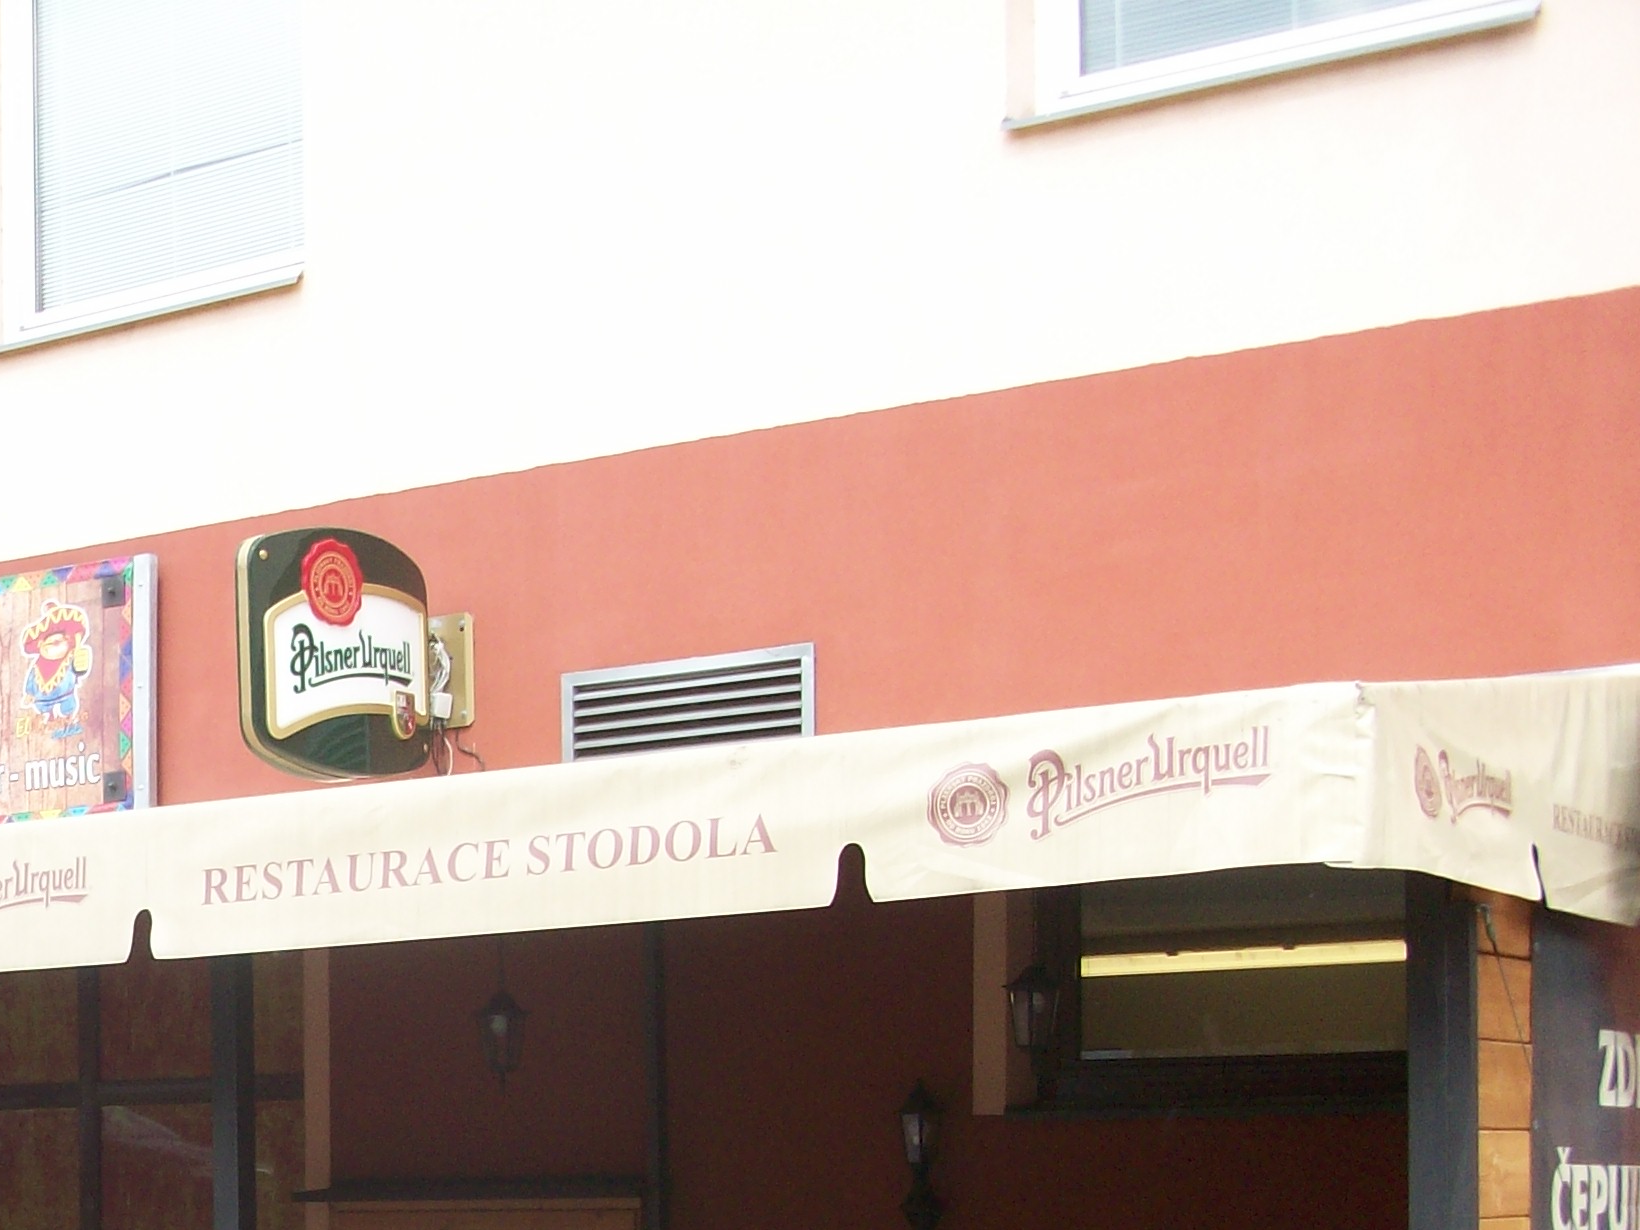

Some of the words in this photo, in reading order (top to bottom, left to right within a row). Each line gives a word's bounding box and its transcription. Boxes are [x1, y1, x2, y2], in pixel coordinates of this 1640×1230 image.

[290, 623, 359, 693] Pilsner
[359, 630, 410, 686] Urquell
[25, 741, 102, 791] music
[1026, 748, 1149, 840] Pilsner
[1148, 726, 1270, 793] Urquell
[13, 856, 88, 908] Urquell
[202, 839, 510, 906] RESTAURACE
[526, 814, 778, 876] STODOLA
[1598, 1029, 1640, 1109] ZD
